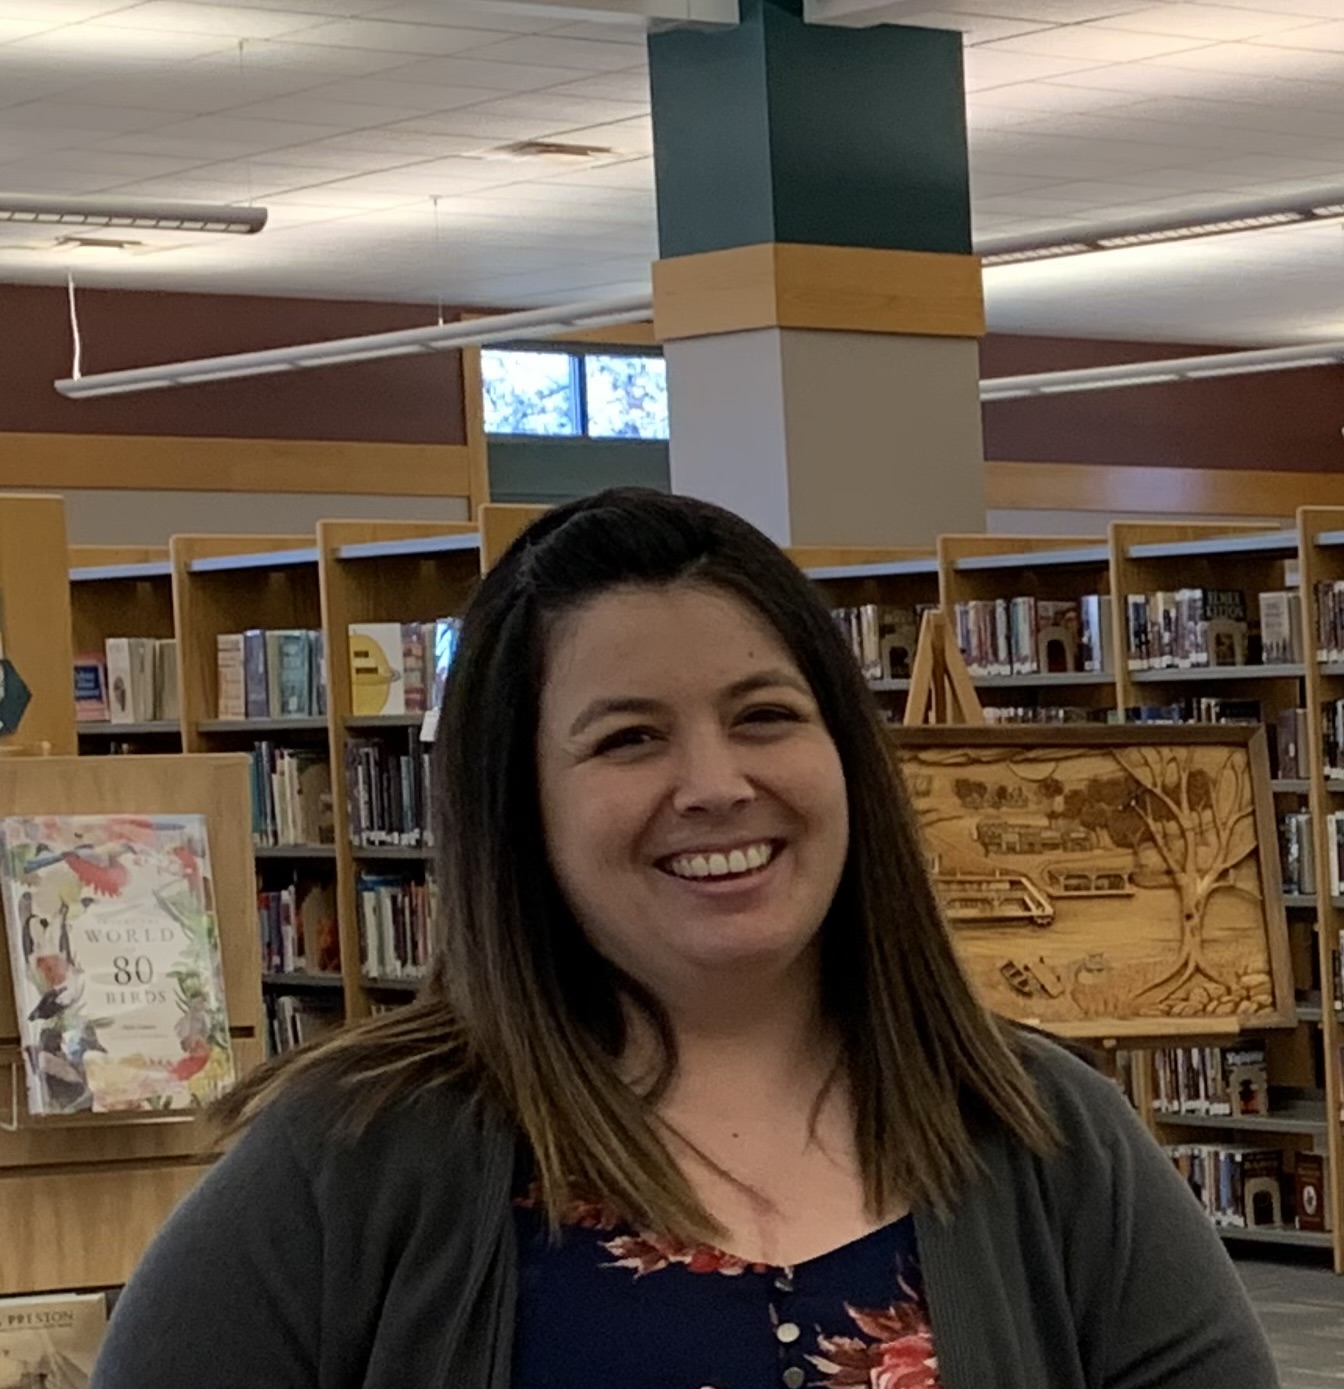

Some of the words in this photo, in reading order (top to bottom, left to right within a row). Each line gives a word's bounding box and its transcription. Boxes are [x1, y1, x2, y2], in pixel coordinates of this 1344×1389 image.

[85, 928, 174, 943] WORLD
[113, 955, 153, 985] 80
[106, 989, 166, 1004] BIRDS
